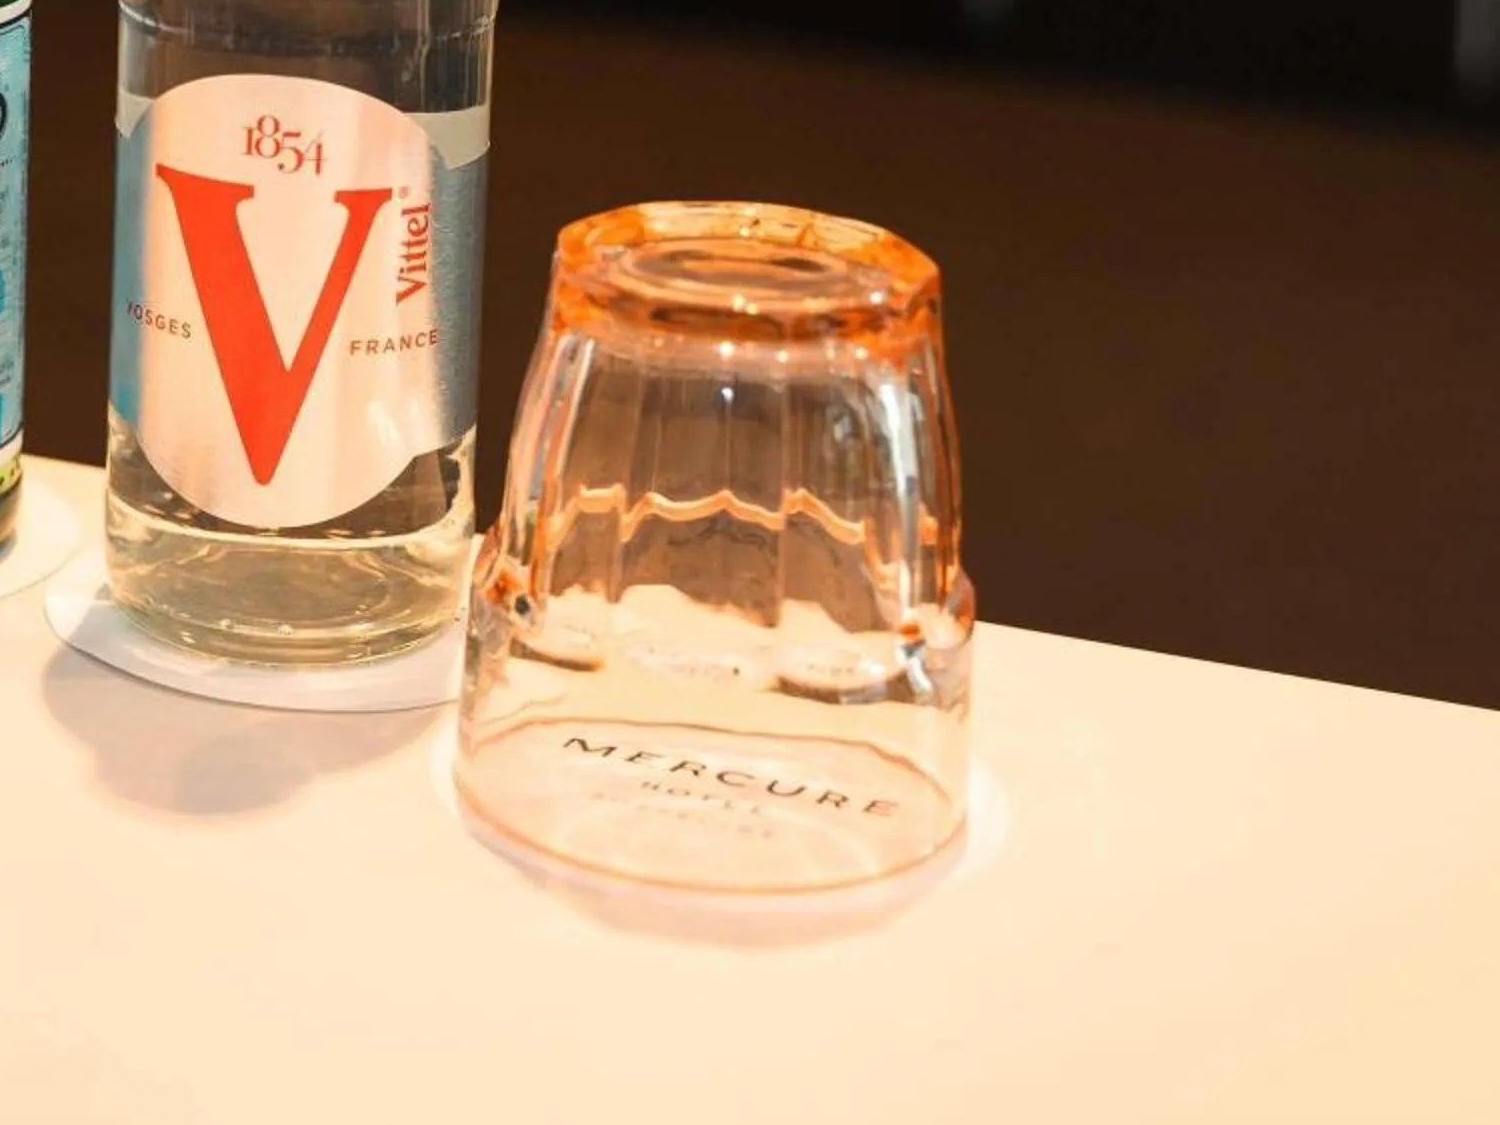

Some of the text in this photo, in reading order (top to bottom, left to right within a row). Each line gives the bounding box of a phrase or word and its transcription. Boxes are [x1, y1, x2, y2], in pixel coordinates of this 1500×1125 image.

[242, 114, 327, 176] 1854
[395, 203, 431, 306] Vittel
[155, 163, 393, 486] V
[350, 329, 439, 355] FRANCE
[563, 737, 900, 816] MERCURE
